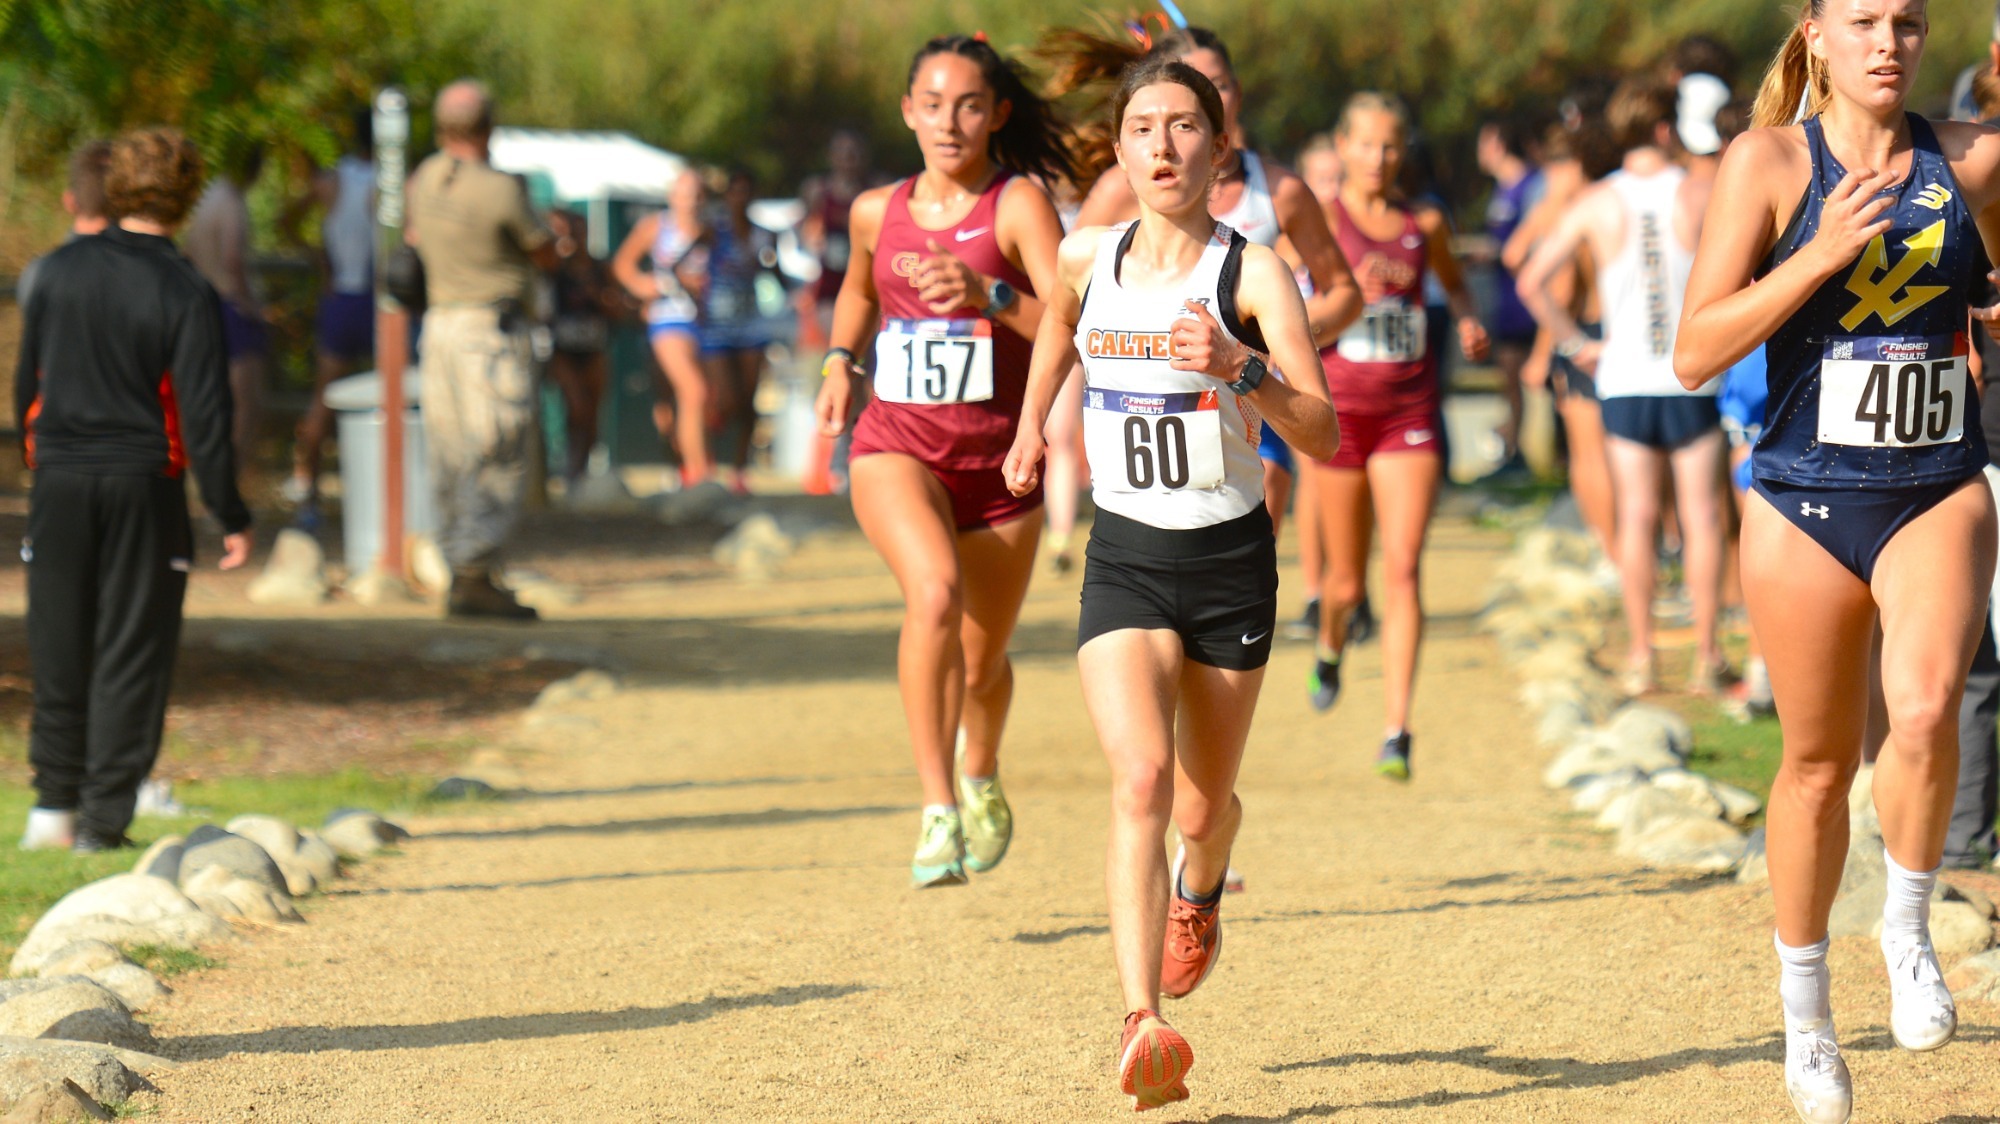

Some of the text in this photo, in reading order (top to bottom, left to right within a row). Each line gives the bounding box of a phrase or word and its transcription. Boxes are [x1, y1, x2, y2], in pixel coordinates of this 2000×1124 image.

[1889, 342, 1929, 350] FINISHED
[1886, 352, 1926, 361] RESULTS
[902, 339, 976, 401] 157
[1128, 396, 1166, 405] FINISHED
[1855, 360, 1955, 444] 405
[1127, 405, 1165, 414] RESULTS
[1123, 416, 1189, 489] 60
